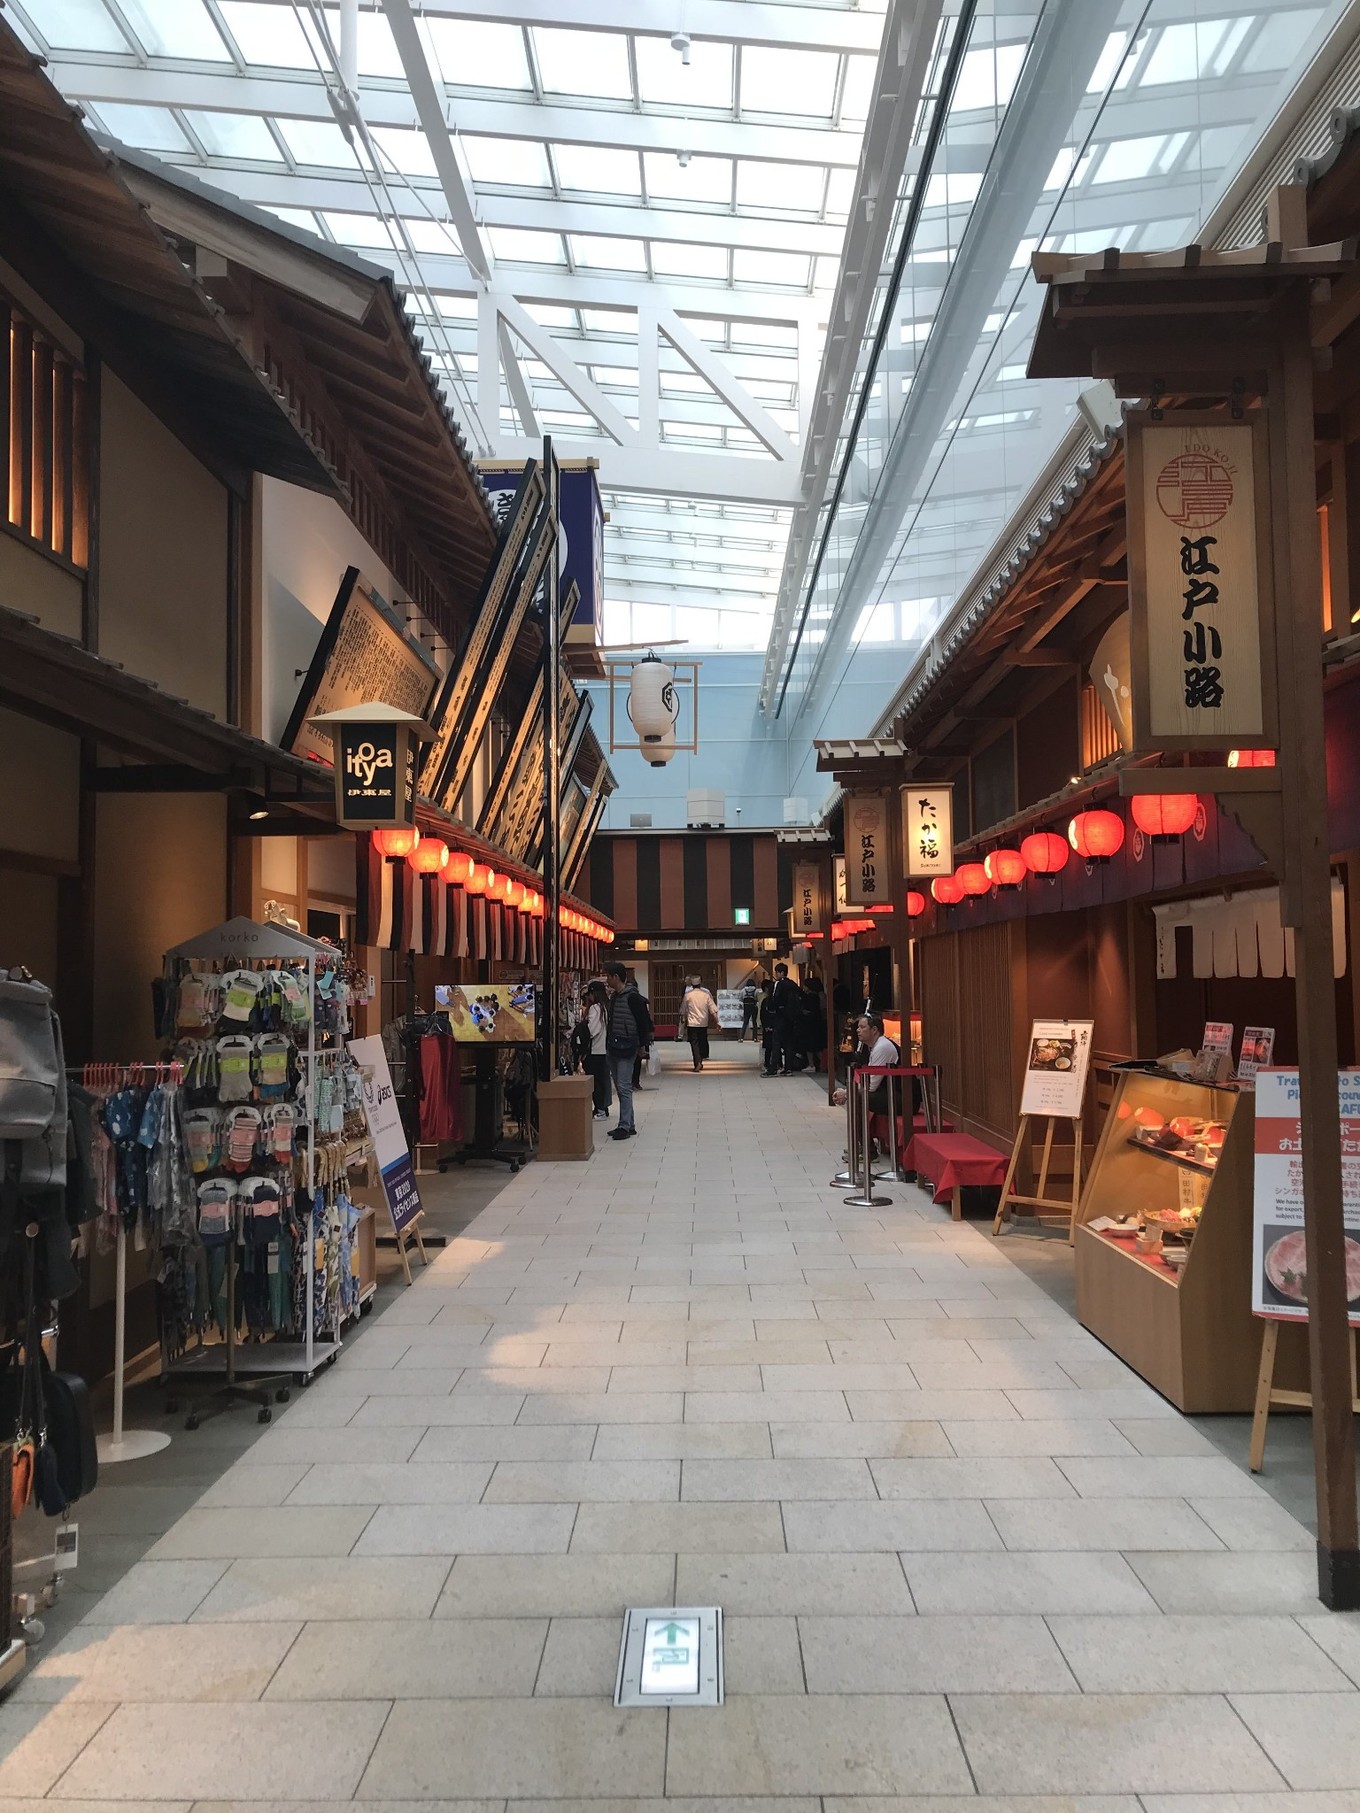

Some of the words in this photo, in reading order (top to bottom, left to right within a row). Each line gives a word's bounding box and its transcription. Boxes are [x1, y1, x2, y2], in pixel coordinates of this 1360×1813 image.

[1184, 444, 1210, 453] EDO
[1180, 536, 1224, 709] 江戸小路
[347, 788, 392, 797] 伊東屋
[918, 798, 940, 859] たか福
[861, 834, 876, 893] 江戸小路
[220, 931, 259, 943] korko
